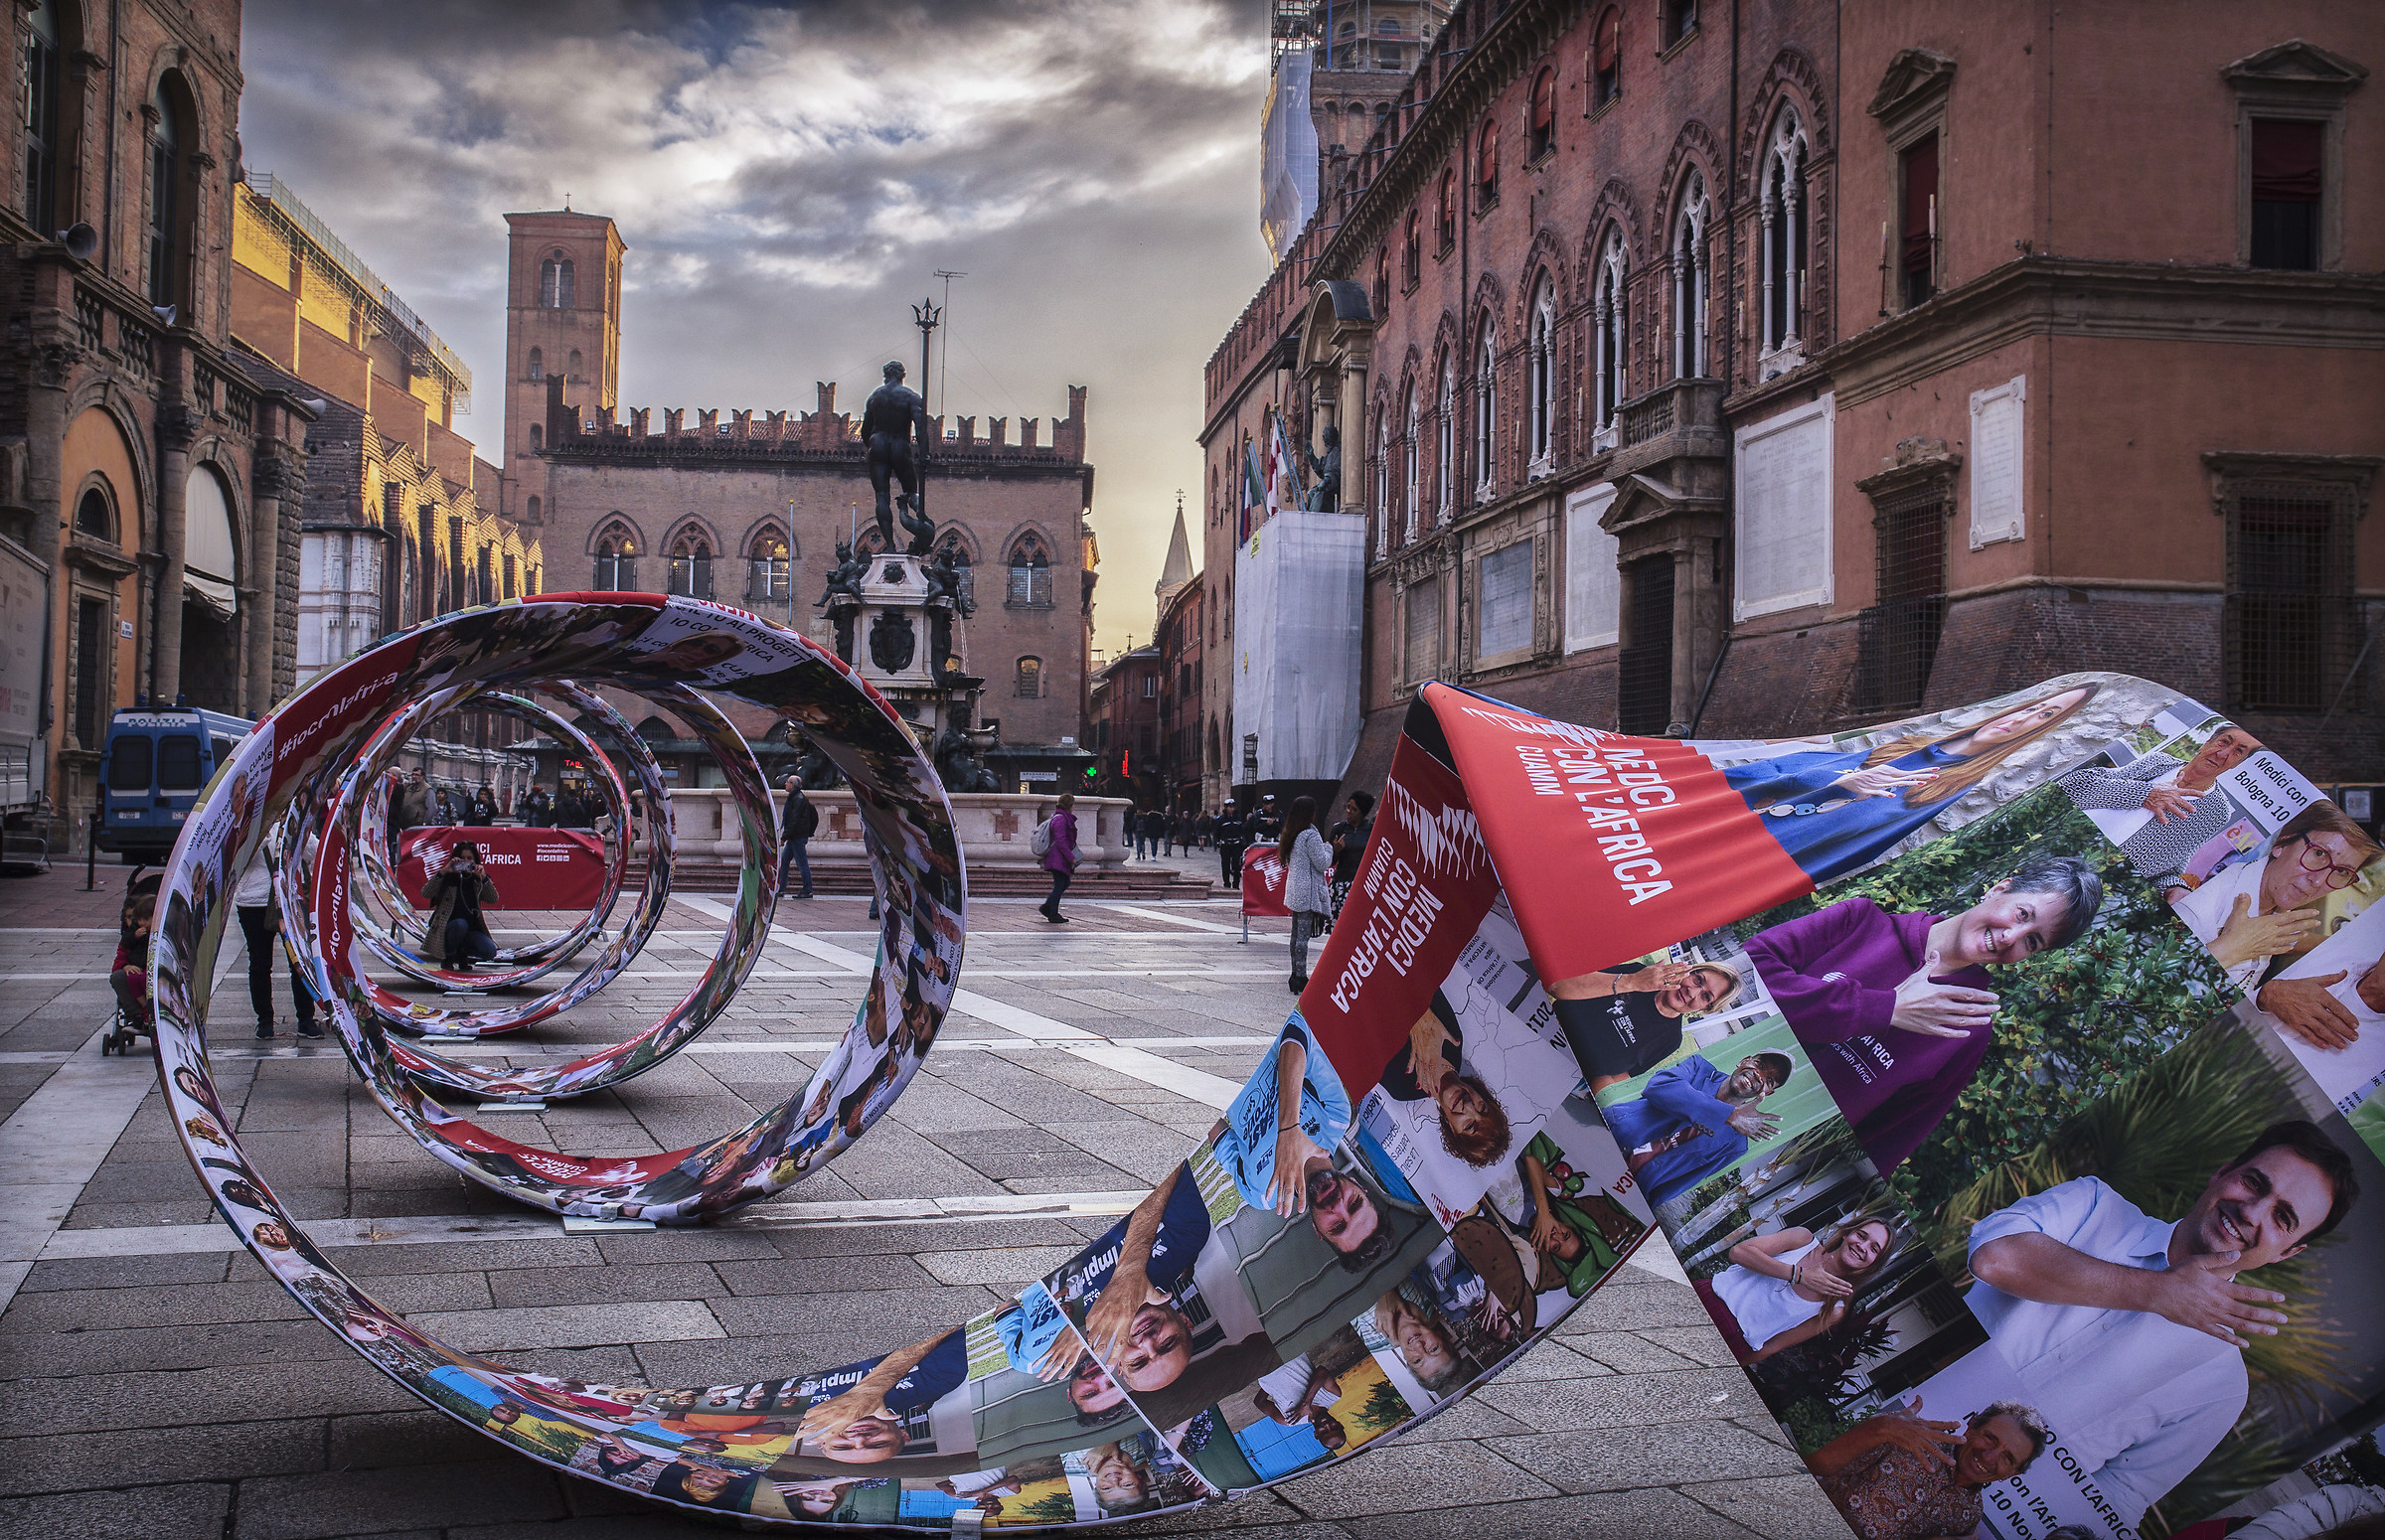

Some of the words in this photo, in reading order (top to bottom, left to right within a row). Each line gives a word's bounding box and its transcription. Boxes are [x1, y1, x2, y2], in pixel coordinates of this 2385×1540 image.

[127, 717, 187, 727] POLIZIA
[1514, 745, 1565, 796] CUAMM
[1552, 748, 1613, 784] CON
[2254, 756, 2293, 789] Medici
[2286, 786, 2308, 807] con
[2234, 770, 2275, 809] Bologna
[2271, 805, 2291, 822] 10
[1362, 837, 1395, 901] CUAMM
[1381, 857, 1417, 918] CON
[1384, 883, 1445, 978] MEDICI
[1330, 905, 1395, 1014] L'AFRICA
[1840, 1048, 1855, 1065] with
[1852, 1063, 1872, 1084] Africa
[1363, 1090, 1383, 1125] Medici
[1988, 1489, 2012, 1511] 10
[2052, 1447, 2088, 1484] CON
[2080, 1482, 2139, 1540] L'AFRIC
